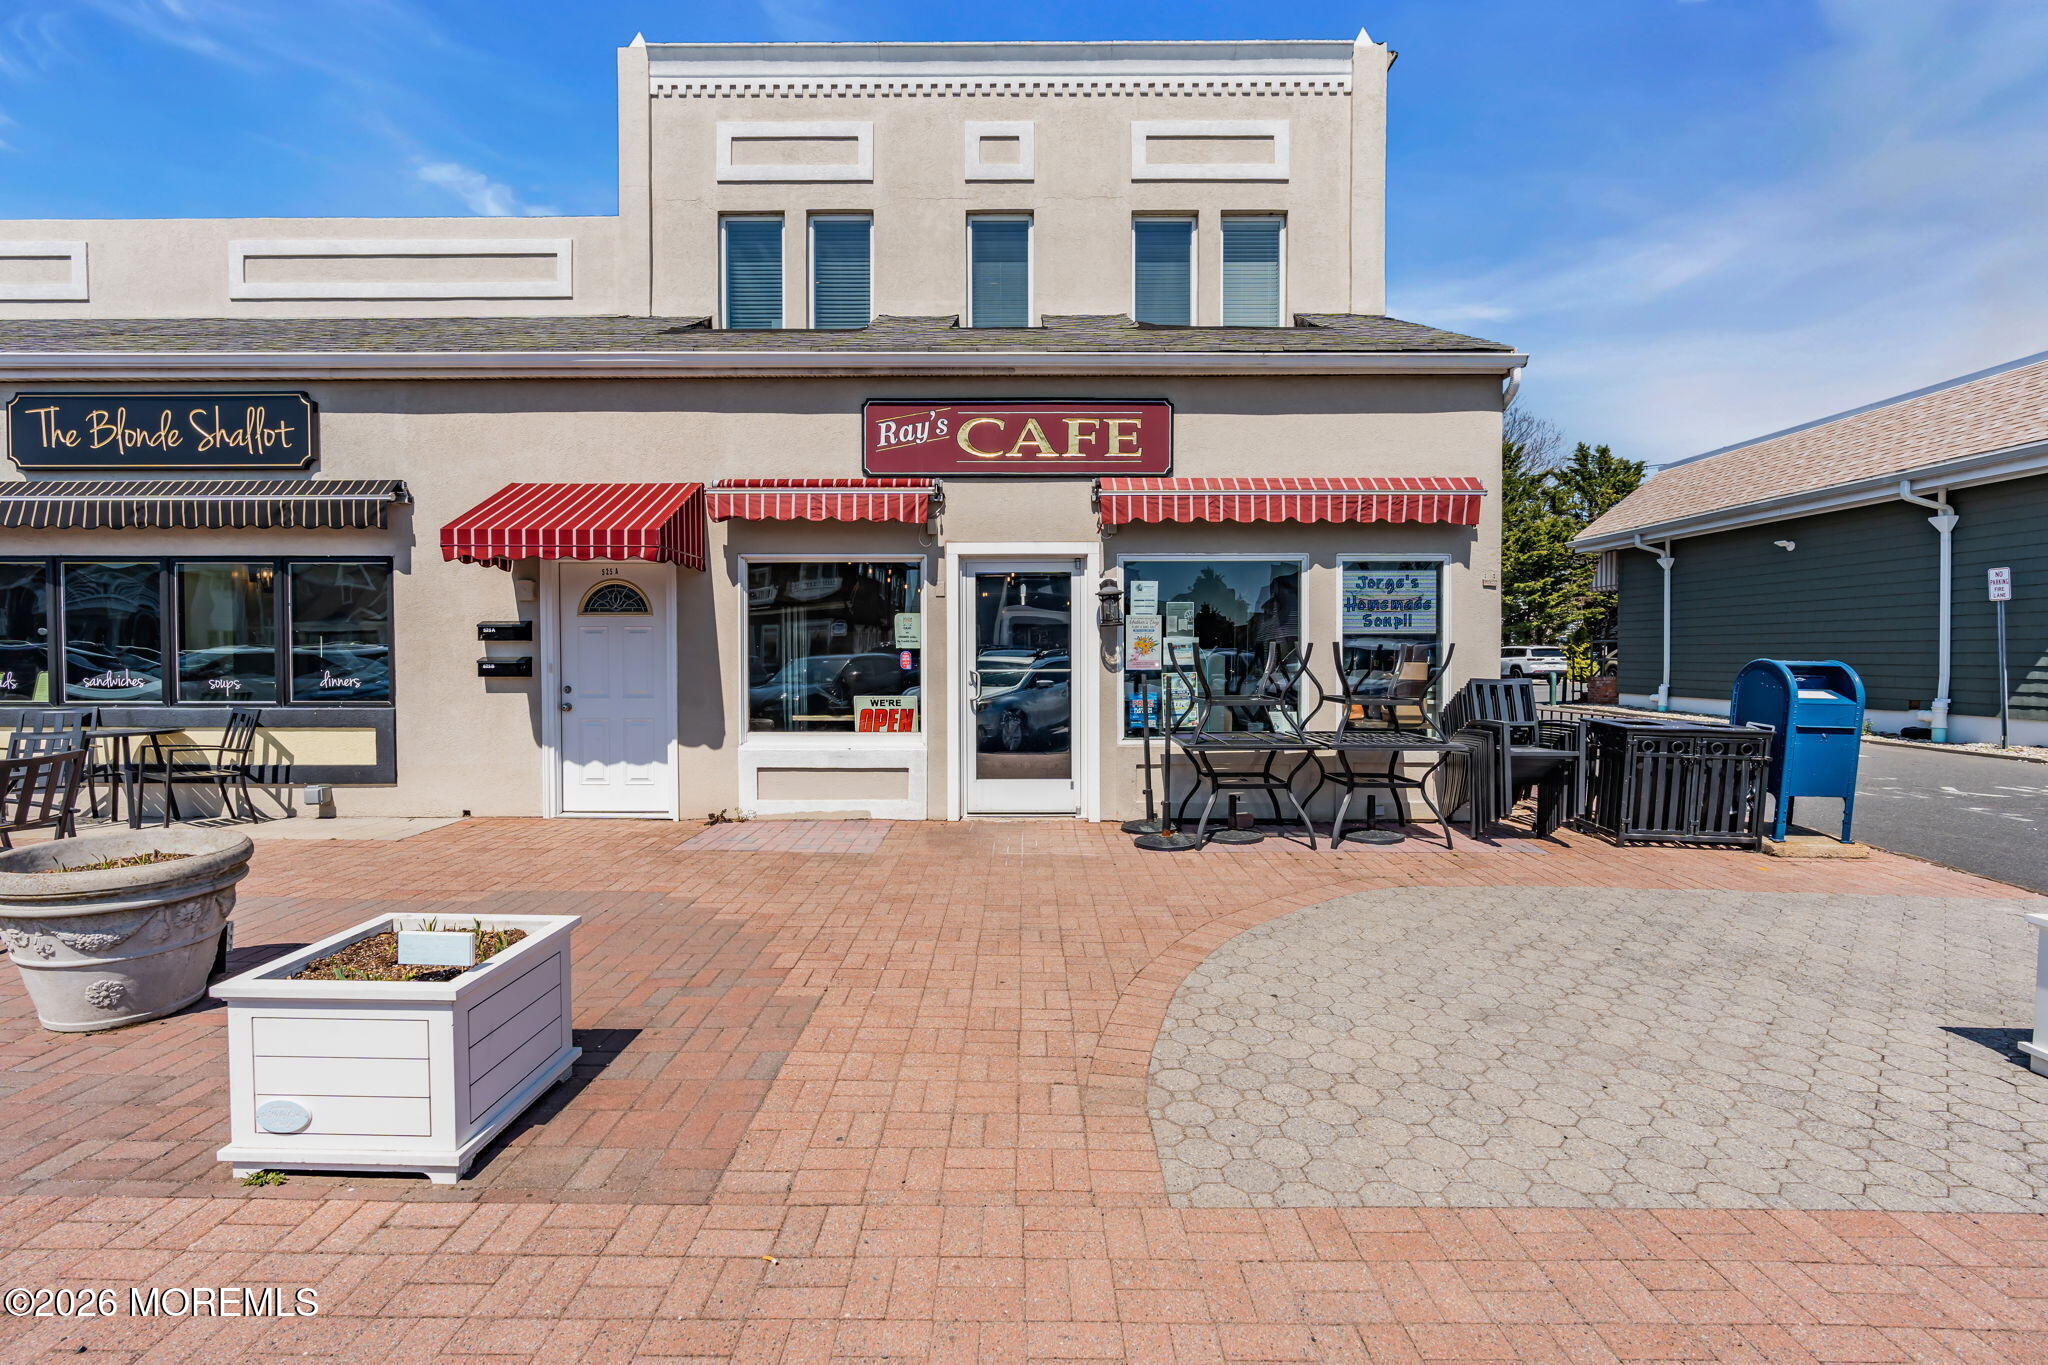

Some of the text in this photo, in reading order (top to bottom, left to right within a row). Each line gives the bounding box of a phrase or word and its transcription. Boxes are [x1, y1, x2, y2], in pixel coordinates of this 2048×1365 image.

[25, 405, 296, 455] The Blonde Shallot
[875, 410, 1143, 458] Ray's CAFE
[1355, 574, 1420, 595] Jorge's
[1344, 595, 1432, 612] Homemade
[82, 668, 146, 689] sandwiches
[208, 678, 242, 697] soups
[319, 670, 362, 689] dinners
[870, 699, 902, 707] WE'RE
[858, 708, 915, 733] OPEN
